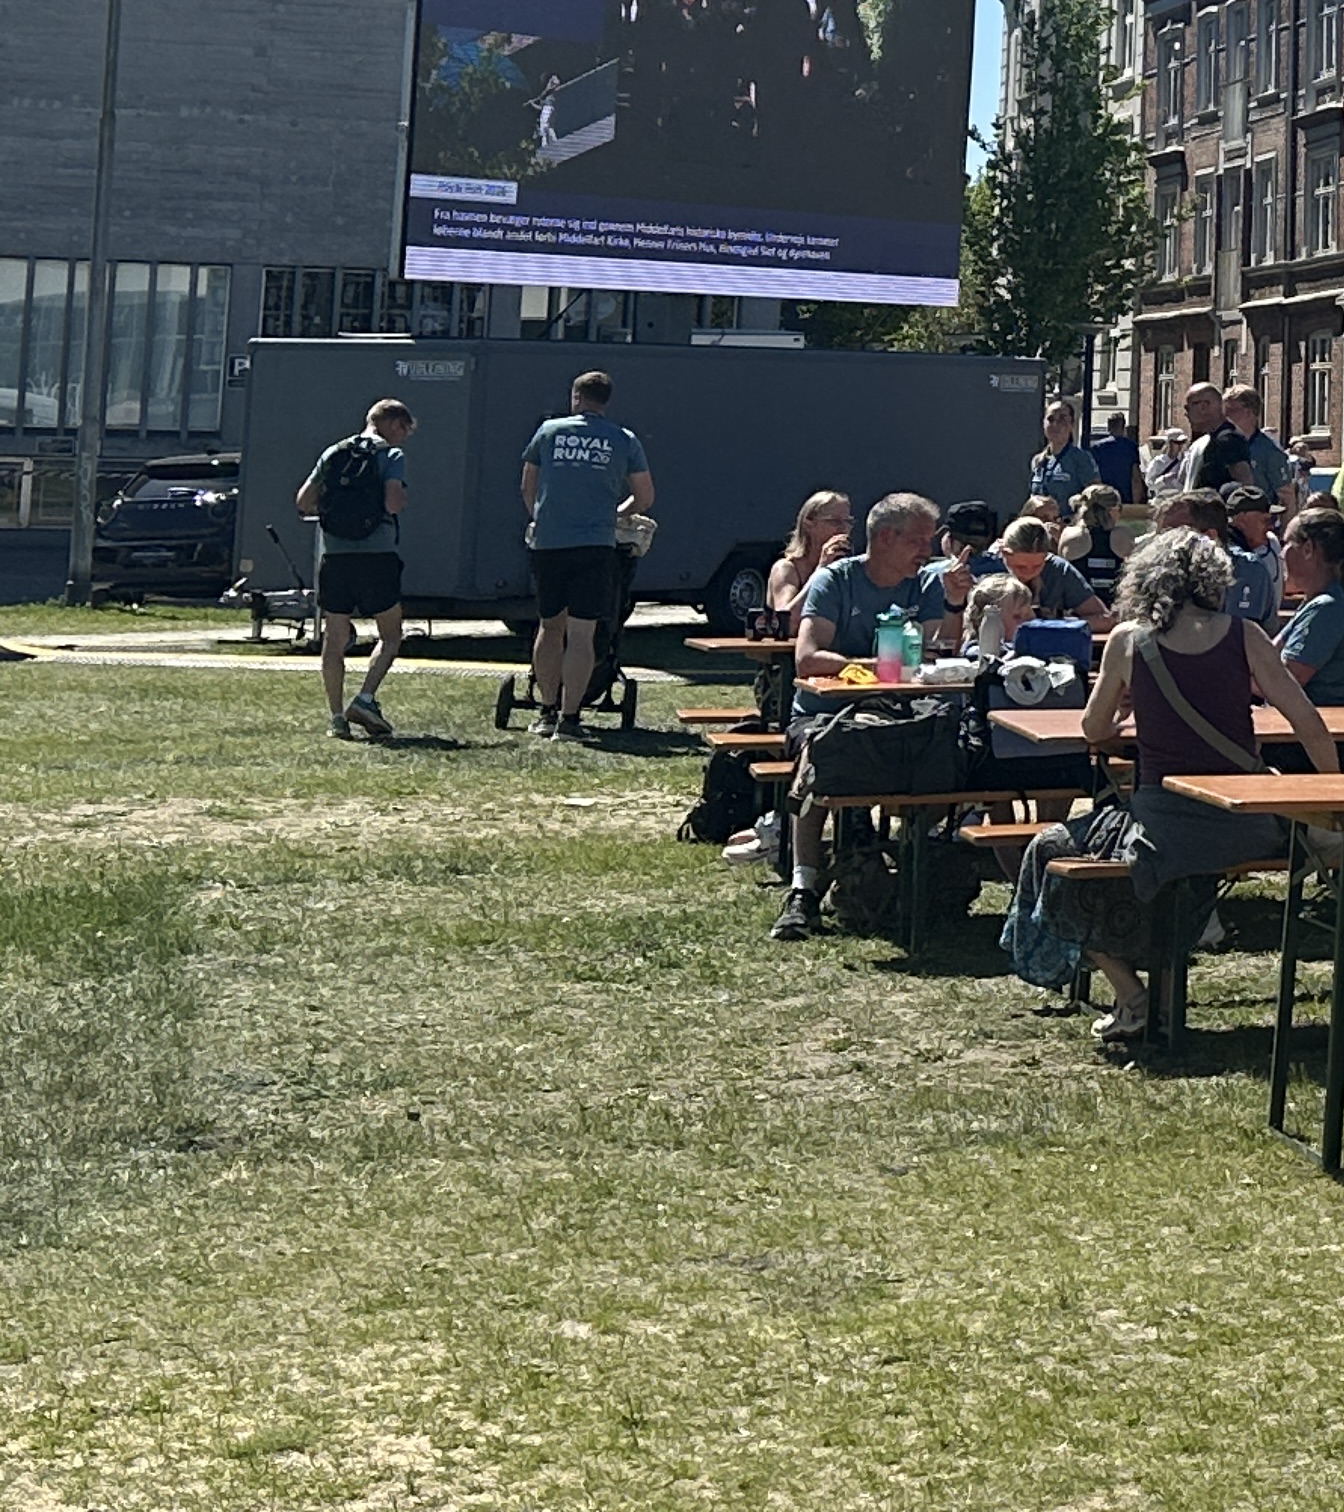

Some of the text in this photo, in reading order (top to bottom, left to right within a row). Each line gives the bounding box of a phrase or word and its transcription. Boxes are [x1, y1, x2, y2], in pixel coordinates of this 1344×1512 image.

[434, 208, 450, 220] Fra
[233, 358, 250, 377] P
[554, 435, 613, 451] ROYAL
